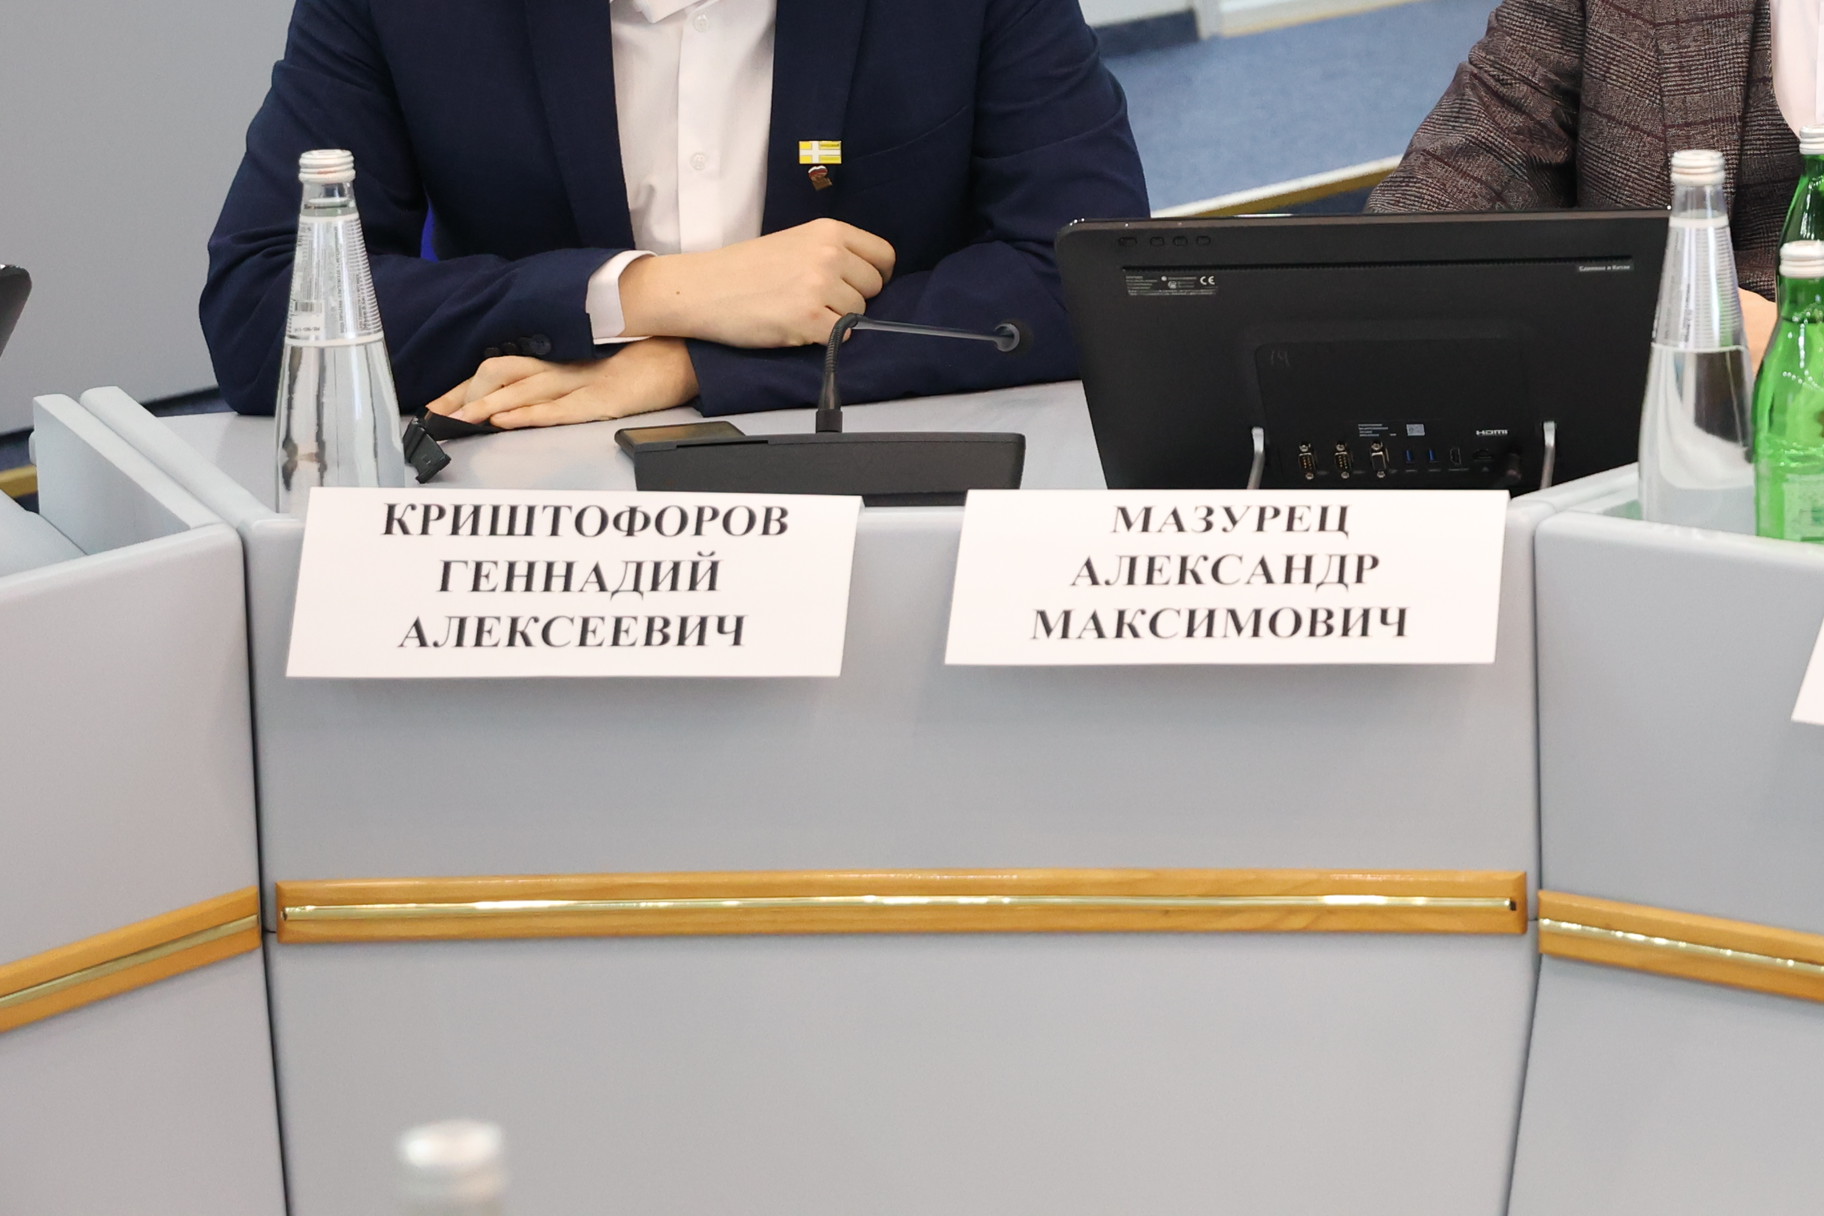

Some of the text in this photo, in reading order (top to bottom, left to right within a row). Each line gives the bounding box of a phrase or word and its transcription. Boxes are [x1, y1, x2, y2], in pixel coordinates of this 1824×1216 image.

[382, 502, 790, 538] КРИШТОФОРОВ
[1112, 504, 1351, 537] МАЗУРЕЦ
[438, 551, 721, 600] ГЕННАДИЙ
[1071, 553, 1381, 592] АЛЕКСАНДР
[398, 613, 748, 650] АЛЕКСЕЕВИЧ
[1030, 605, 1411, 641] МАКСИМОВИЧ
